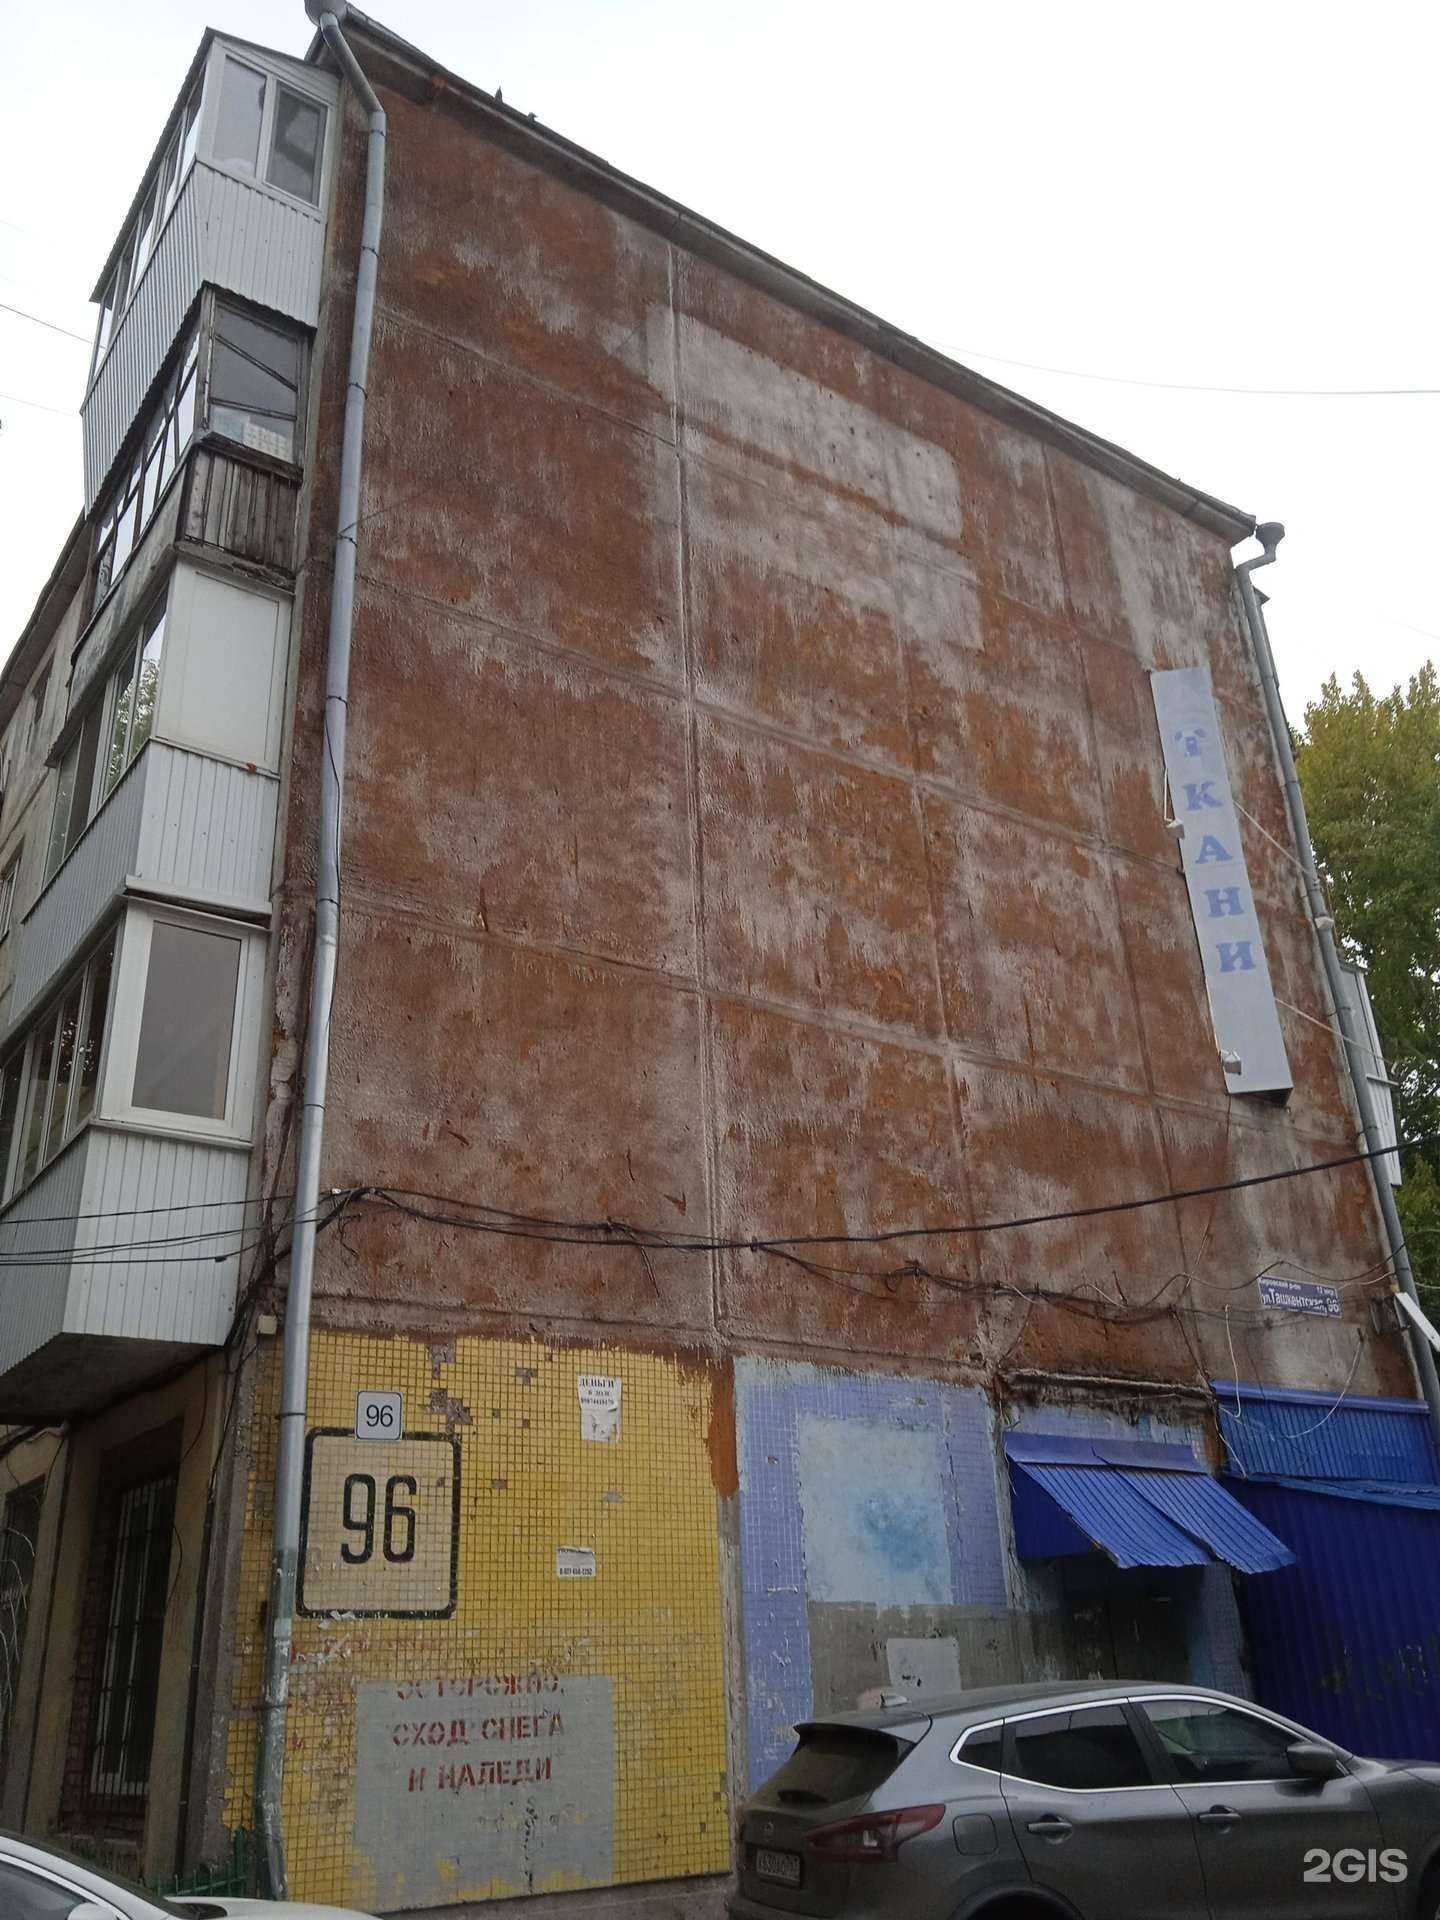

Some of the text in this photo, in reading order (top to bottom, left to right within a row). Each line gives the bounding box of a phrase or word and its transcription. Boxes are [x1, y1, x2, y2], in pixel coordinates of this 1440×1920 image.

[1174, 728, 1256, 974] ТКАНИ
[366, 1404, 394, 1427] 96
[341, 1473, 417, 1564] 96
[392, 1714, 564, 1747] СХОД СНЕГА
[408, 1756, 552, 1793] И НАЛЕДИ
